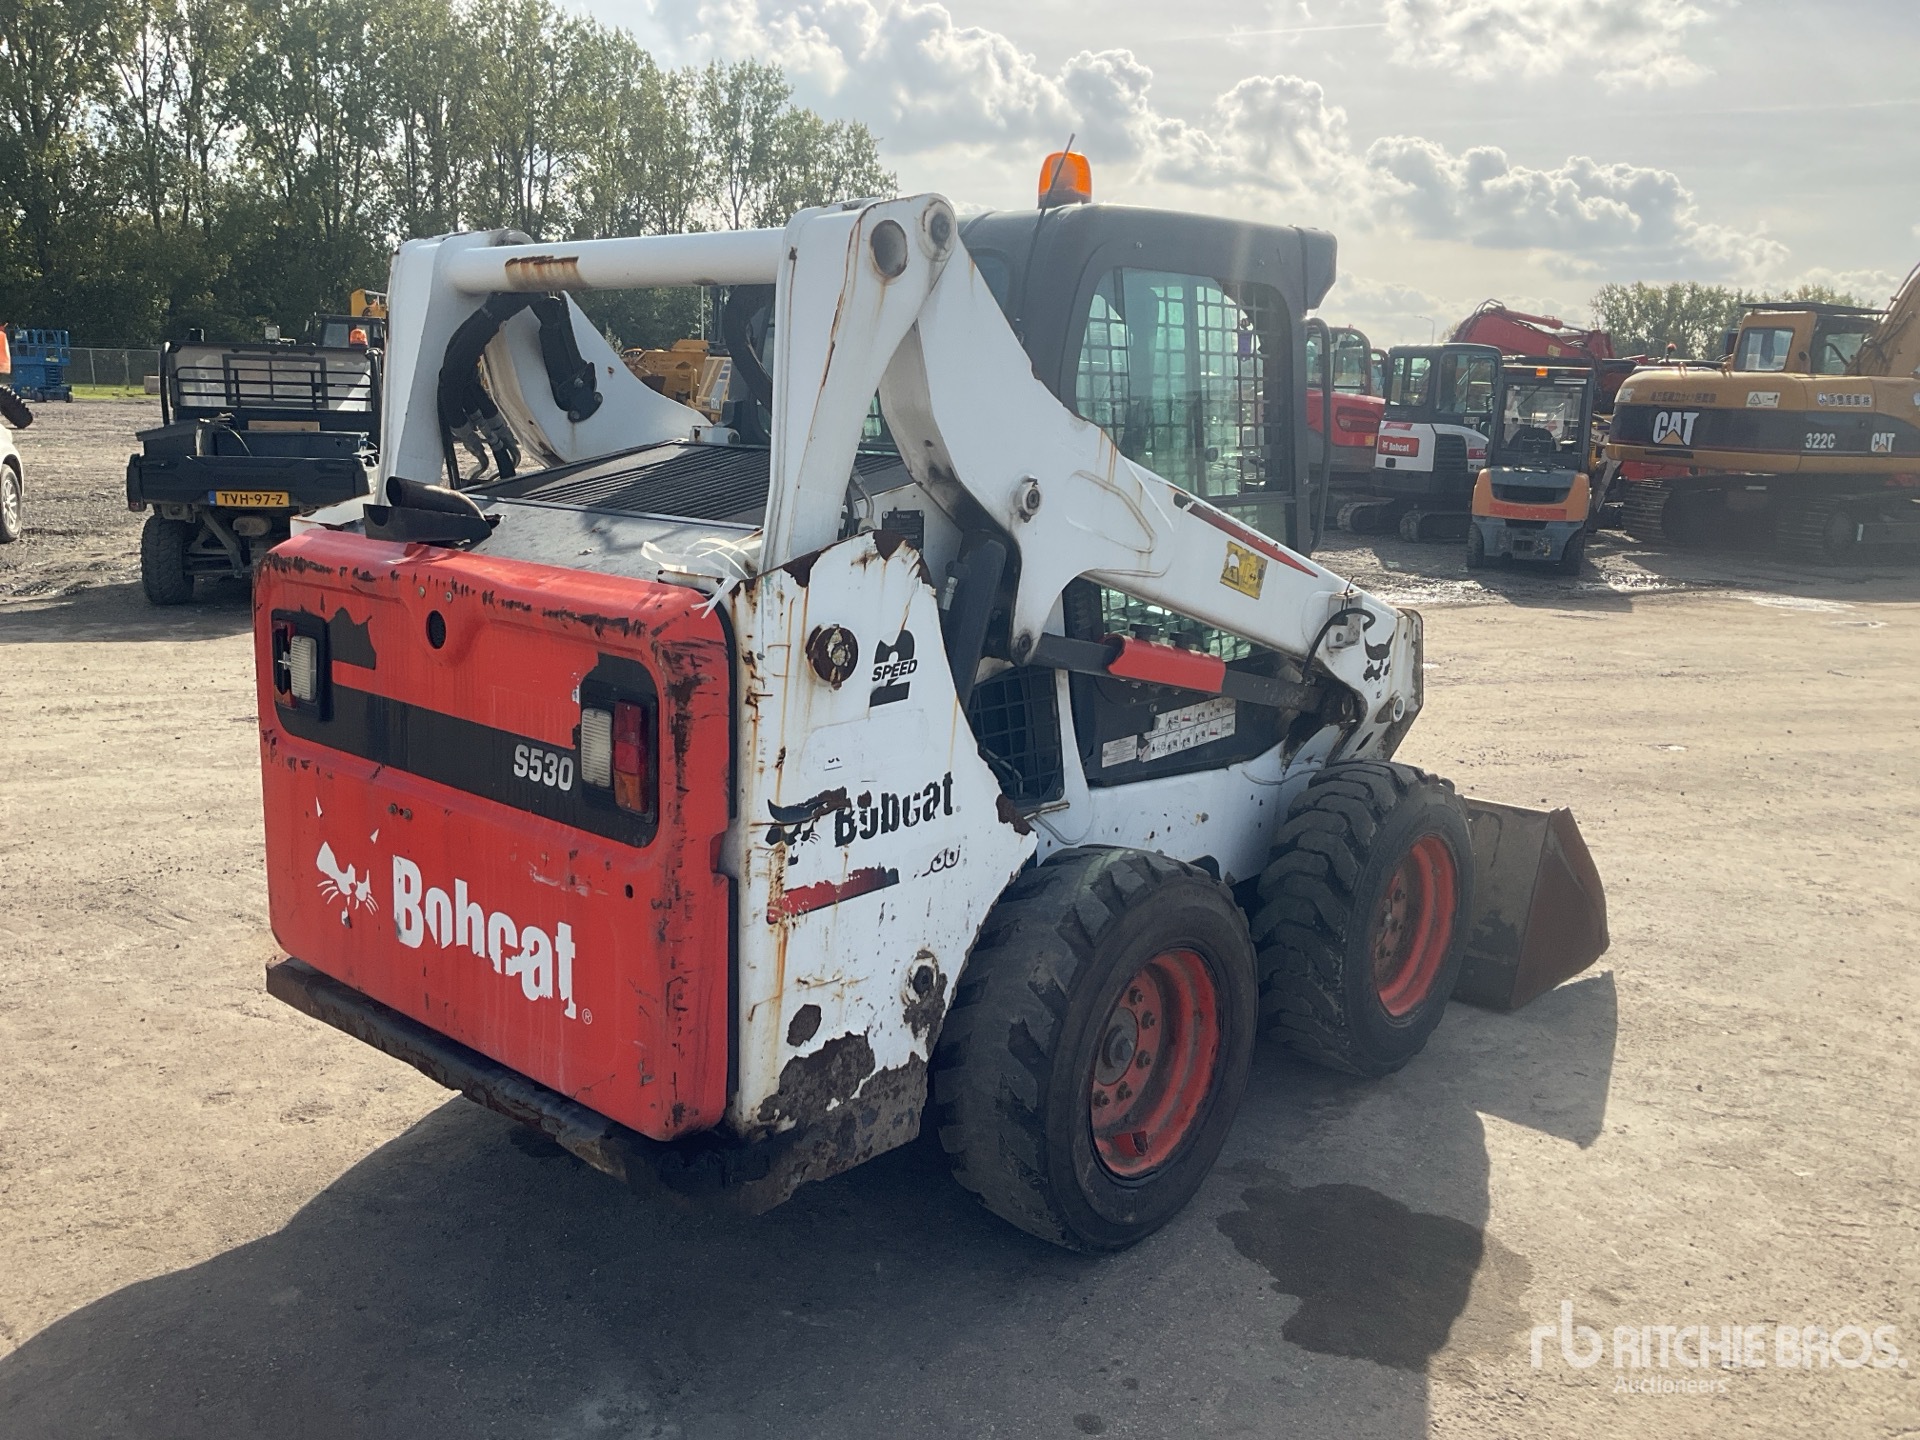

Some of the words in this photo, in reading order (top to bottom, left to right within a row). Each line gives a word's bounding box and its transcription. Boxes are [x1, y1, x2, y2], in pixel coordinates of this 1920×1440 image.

[1652, 411, 1699, 445] CAT
[1388, 442, 1409, 452] Bobcat
[1805, 432, 1836, 449] 322C
[1870, 432, 1896, 452] CAT
[221, 493, 284, 505] TVH-97-Z
[871, 659, 918, 681] SPEED
[513, 743, 574, 791] S530
[392, 854, 577, 1019] Bobcat
